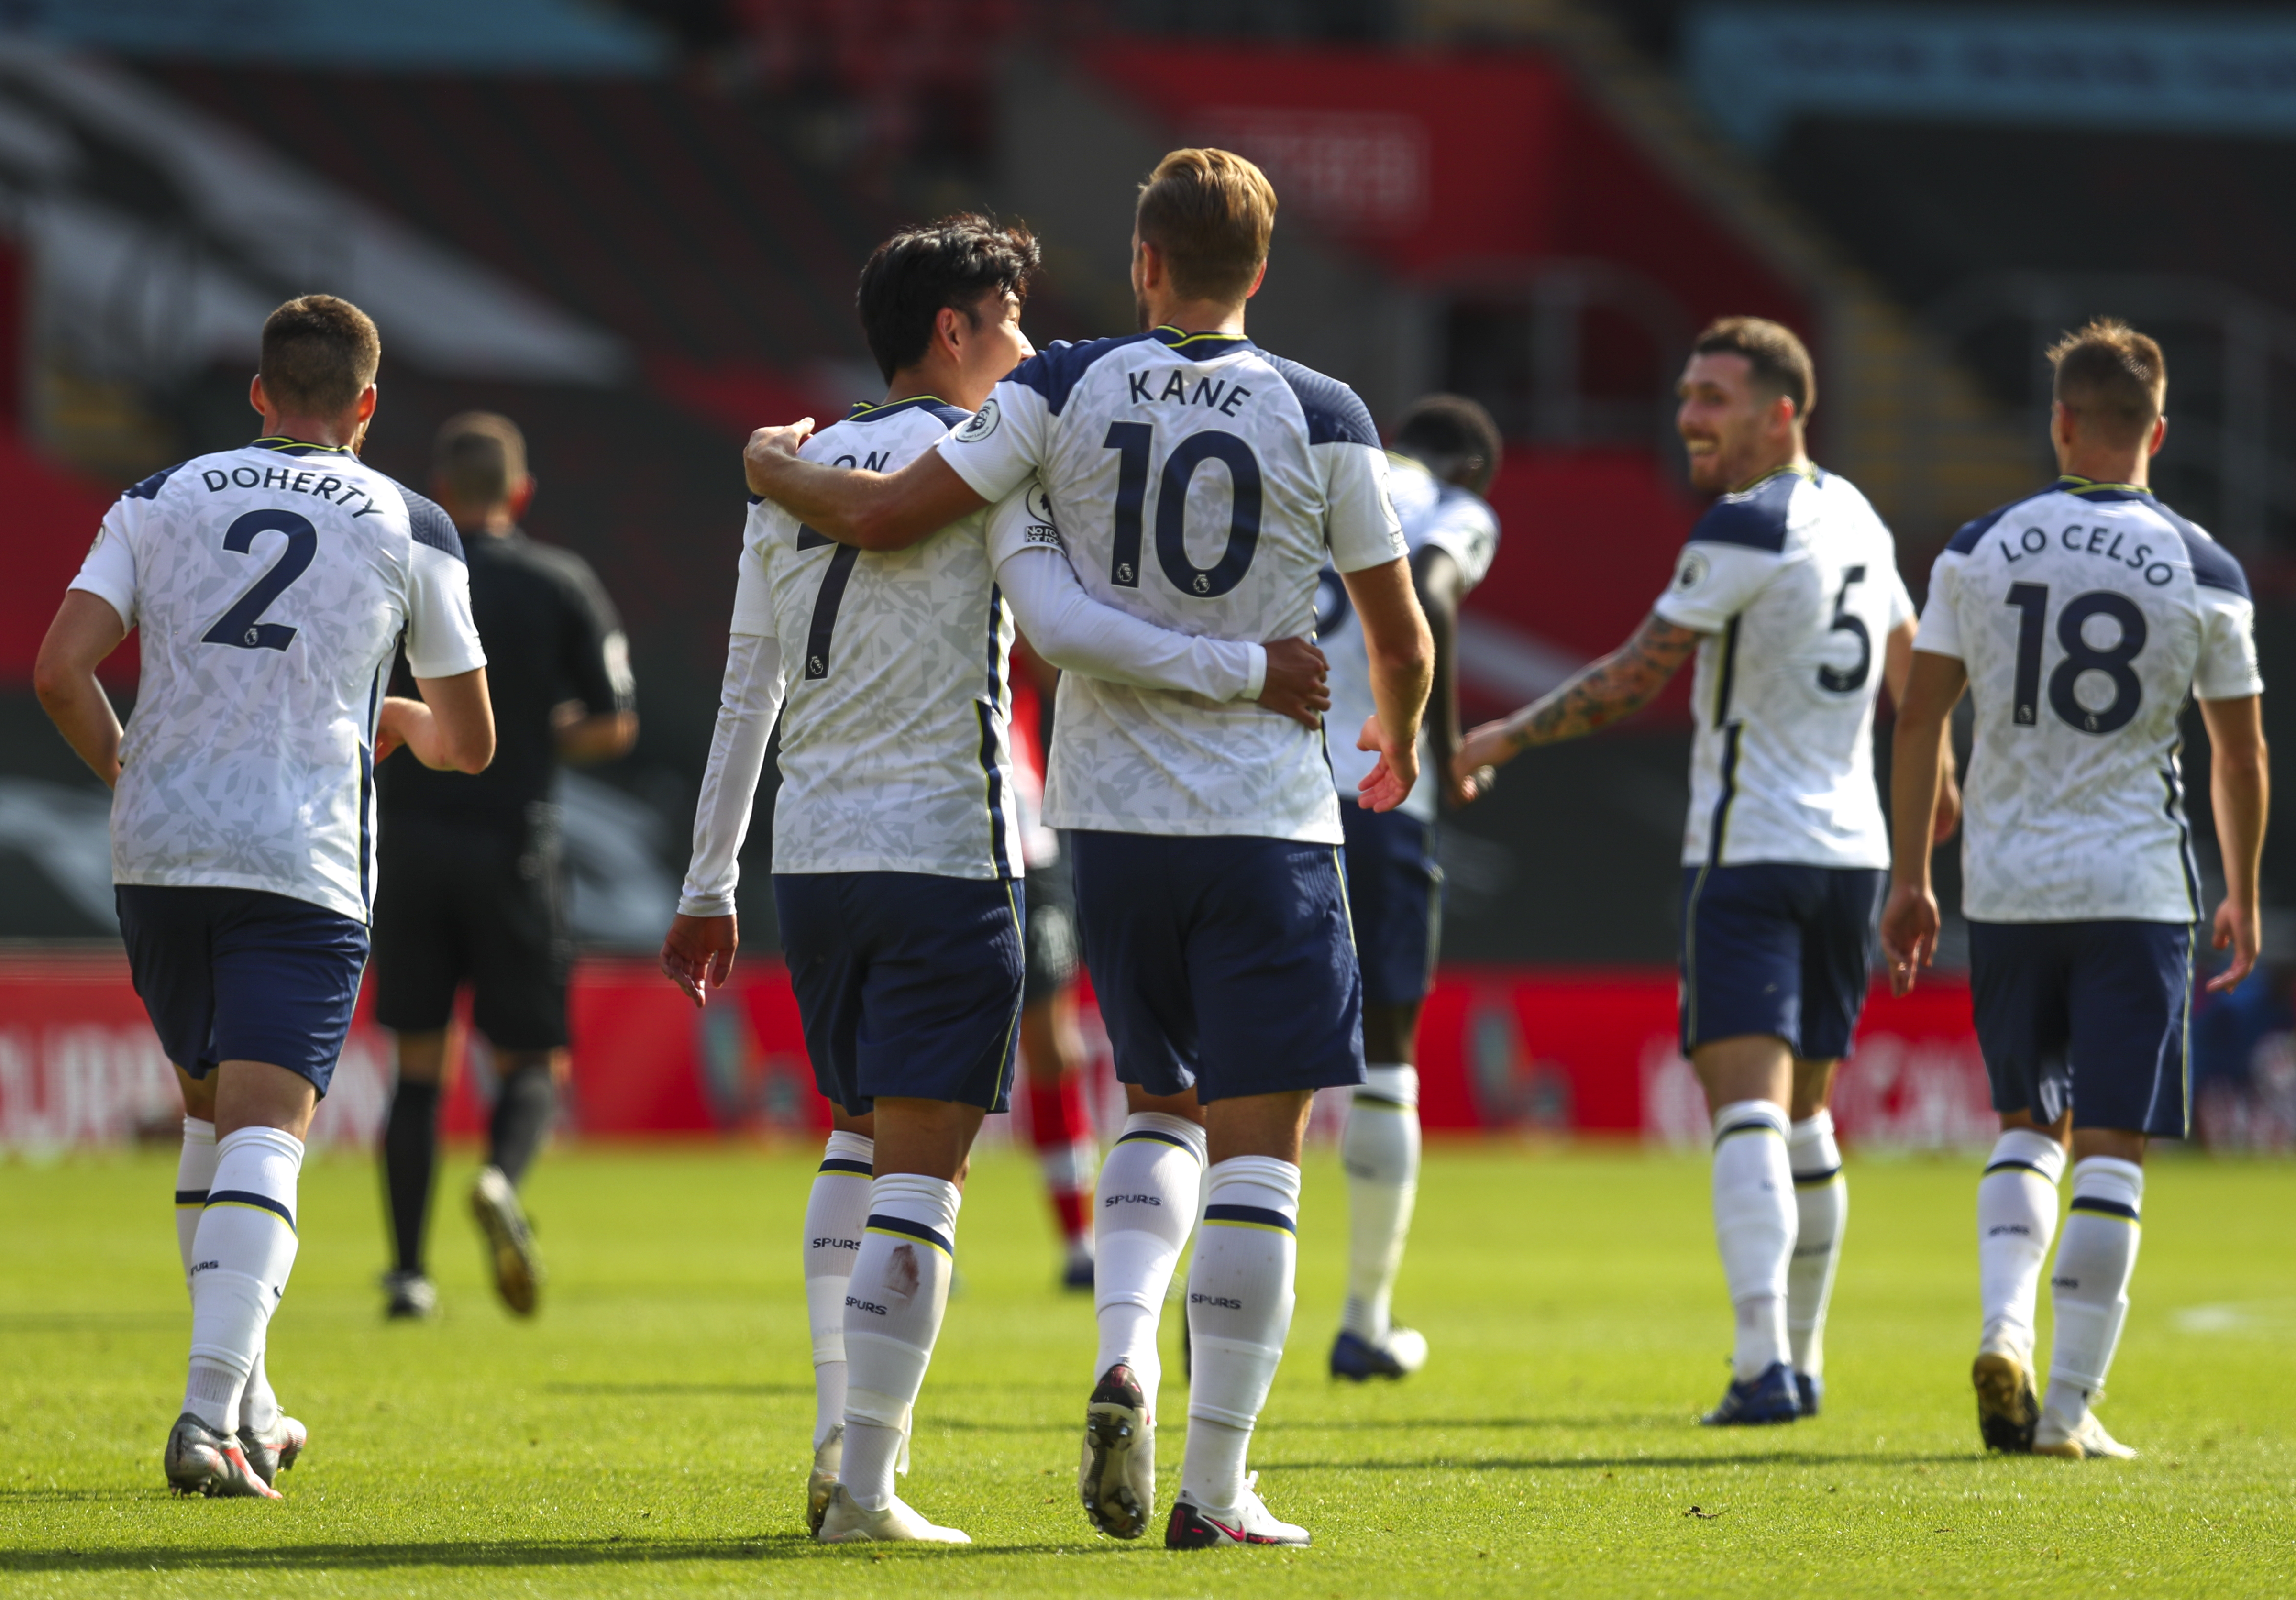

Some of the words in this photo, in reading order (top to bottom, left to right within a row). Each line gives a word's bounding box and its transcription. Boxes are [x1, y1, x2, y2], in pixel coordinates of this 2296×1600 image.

[1128, 369, 1251, 417] KANE
[202, 467, 384, 519] DOHERTY
[1103, 420, 1263, 598] 10
[1026, 526, 1043, 535] No
[1045, 528, 1060, 541] ro
[1999, 527, 2046, 563] LO
[2061, 525, 2173, 586] CELSO
[201, 508, 319, 652] 2
[796, 522, 861, 681] 7
[1819, 565, 1871, 693] 5
[2005, 581, 2148, 734] 18
[1105, 1194, 1162, 1207] SPURS
[191, 1260, 218, 1276] PURS
[813, 1237, 861, 1251] SPURS
[845, 1296, 887, 1316] SPURS
[1191, 1293, 1242, 1310] SPURS
